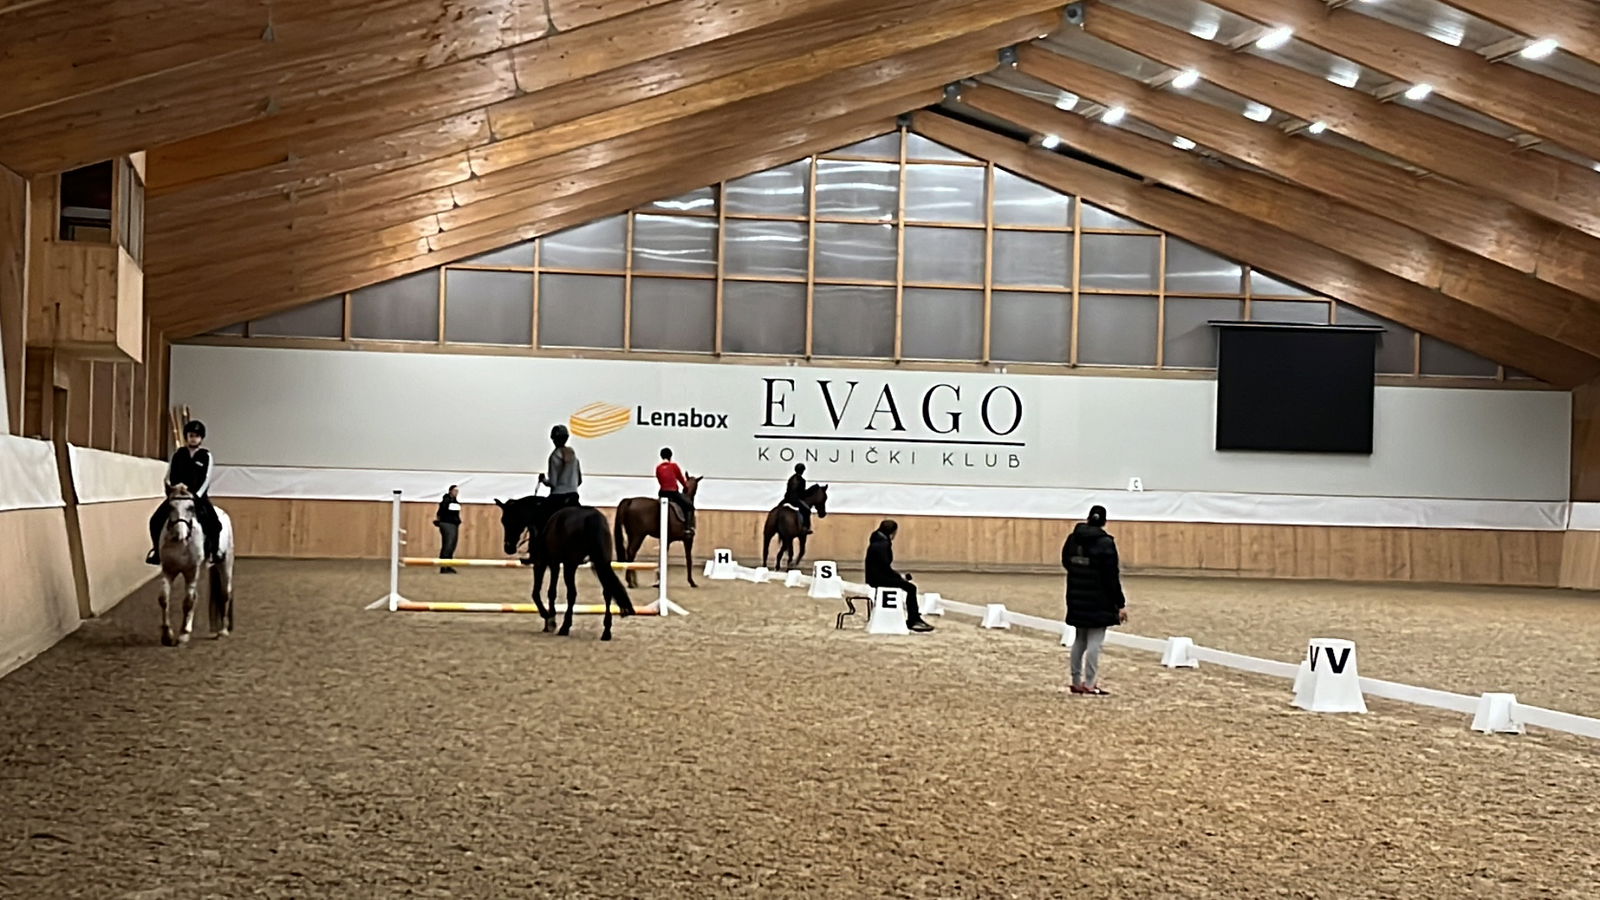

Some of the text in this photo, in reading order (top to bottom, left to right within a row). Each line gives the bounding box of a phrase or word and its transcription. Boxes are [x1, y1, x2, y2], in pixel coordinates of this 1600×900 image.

[636, 405, 729, 429] Lenabox
[761, 377, 1023, 436] EVAGO
[757, 445, 1021, 469] KONJIČKI KLUB
[718, 552, 729, 564] H
[820, 565, 833, 579] S
[881, 590, 898, 609] E
[1324, 647, 1352, 674] V
